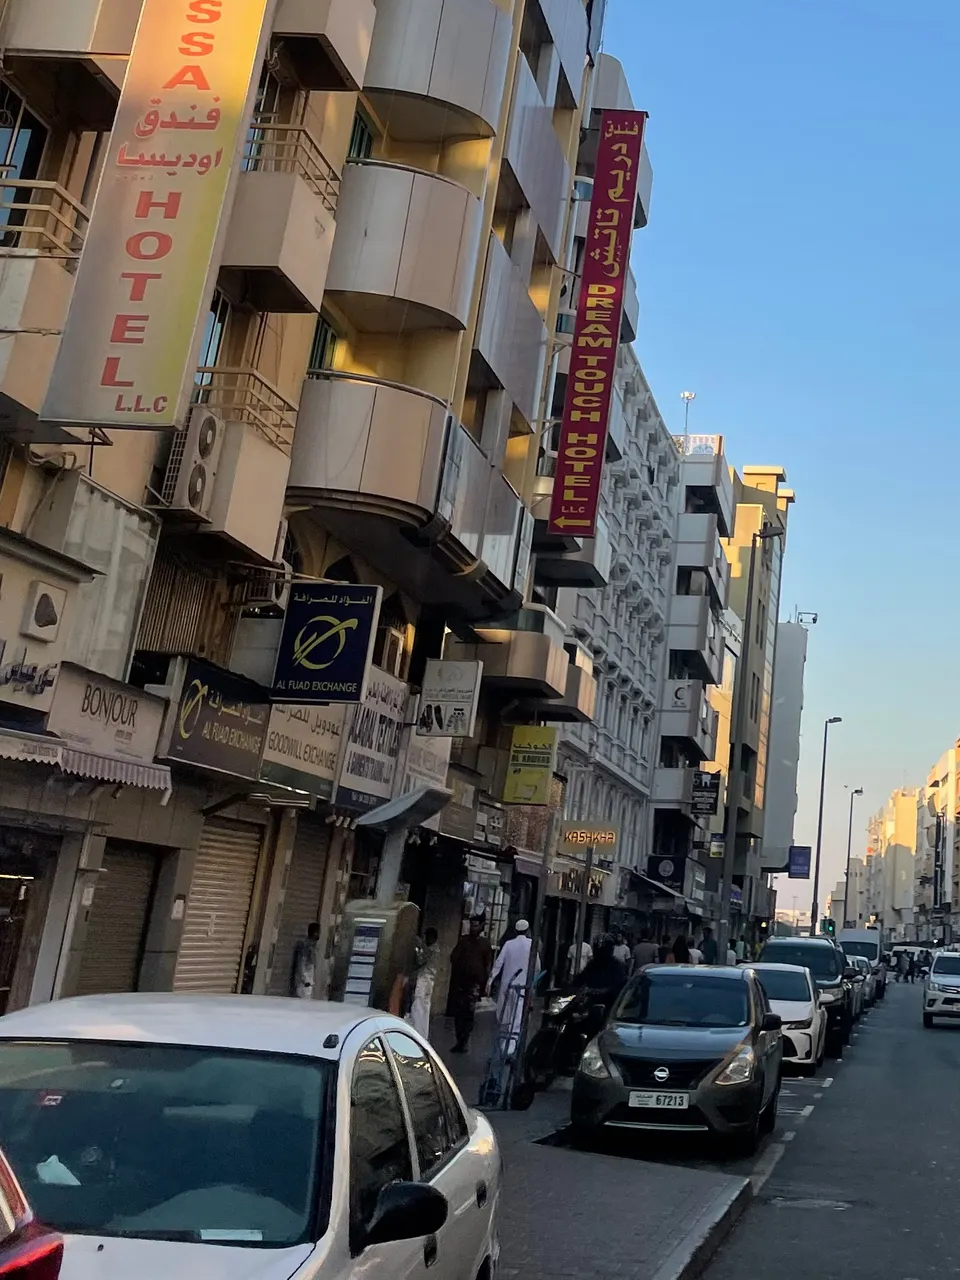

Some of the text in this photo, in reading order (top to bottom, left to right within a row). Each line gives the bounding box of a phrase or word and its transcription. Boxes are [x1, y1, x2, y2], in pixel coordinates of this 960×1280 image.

[135, 96, 221, 138] فندق
[604, 120, 639, 139] فندق
[117, 141, 223, 176] اوديسا
[100, 191, 182, 387] HOTEL
[114, 394, 168, 413] L.L.C
[563, 284, 616, 501] DREAM TOUCH HOTEL
[294, 592, 338, 605] للصرافة
[276, 680, 358, 693] AL FUAD EXCHANGE
[81, 684, 138, 727] BONJOUR
[269, 731, 302, 760] GOODWILL
[303, 744, 337, 771] EXCHANGE
[656, 1095, 684, 1106] 67213
